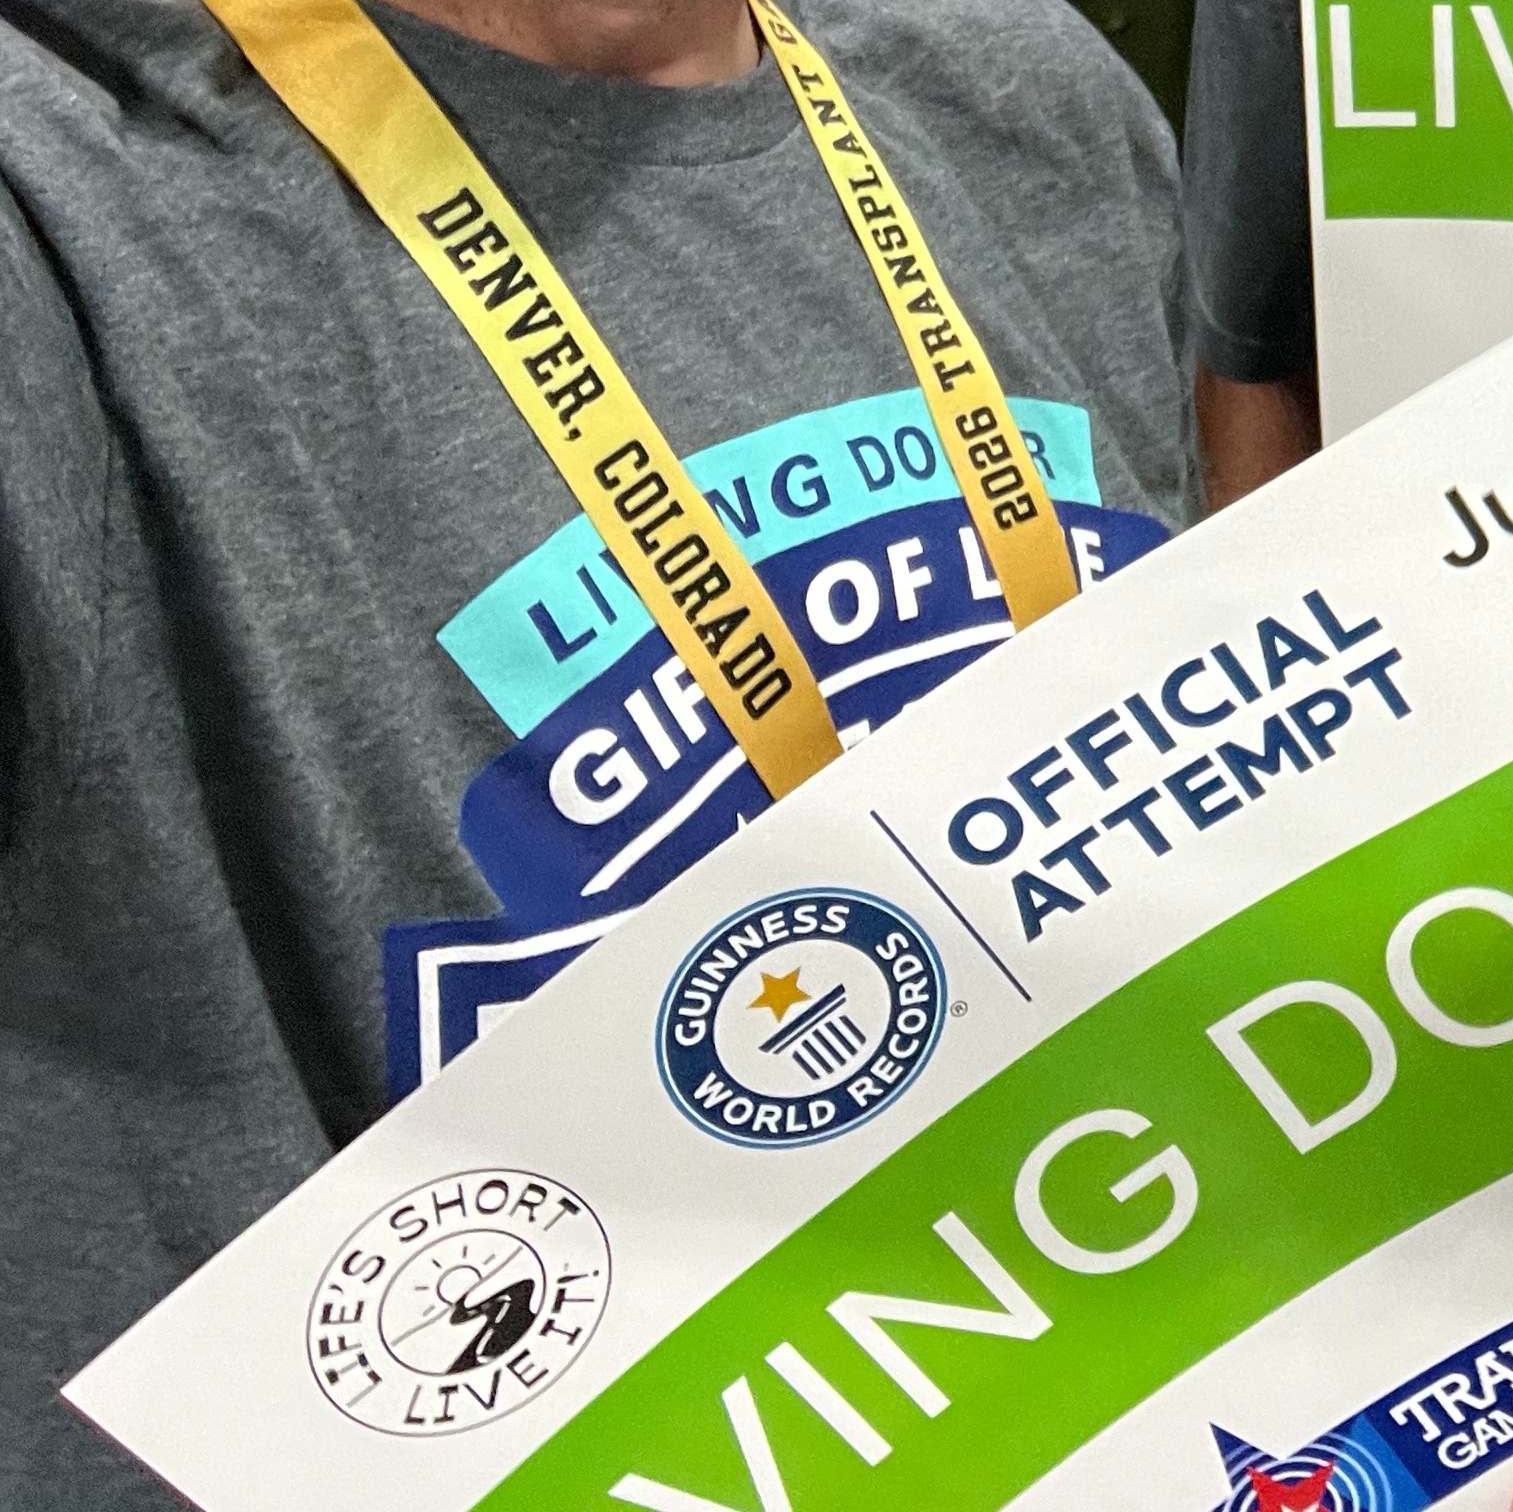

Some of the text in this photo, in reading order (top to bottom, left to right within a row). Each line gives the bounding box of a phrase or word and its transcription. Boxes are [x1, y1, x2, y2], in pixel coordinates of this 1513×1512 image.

[792, 63, 976, 391] TRANSPLANT
[417, 187, 792, 721] DENVER, COLORADO
[527, 453, 832, 665] LING
[956, 405, 1040, 531] 2026
[547, 654, 708, 827] GIF
[805, 536, 934, 645] OF
[946, 588, 1384, 866] OFFICIAL
[1008, 646, 1413, 944] ATTEMPT
[674, 904, 851, 1048] GUINNESS
[692, 931, 931, 1134] WORLD RECORDS
[317, 1178, 583, 1408] LIFE'S SHORT
[402, 1268, 601, 1426] LIVE IT!
